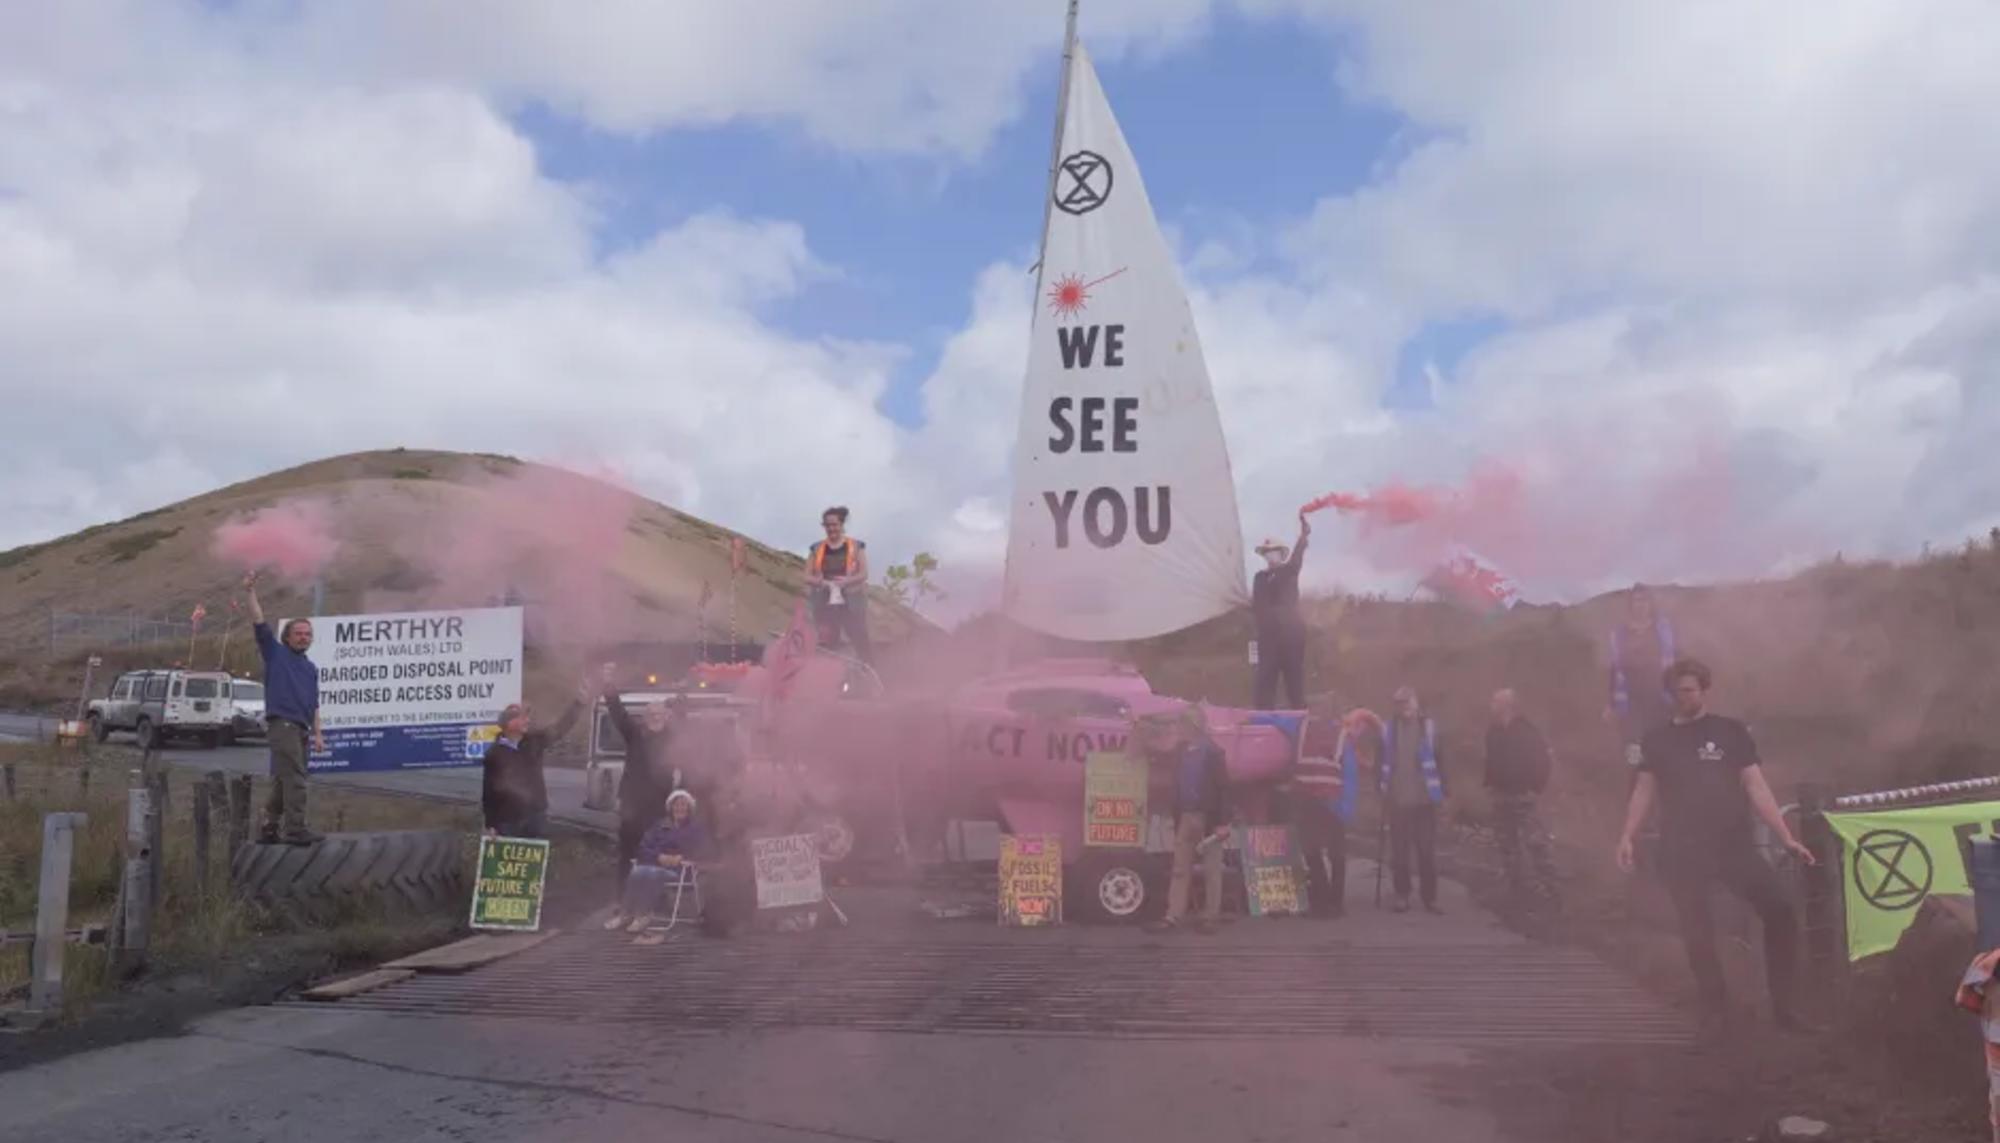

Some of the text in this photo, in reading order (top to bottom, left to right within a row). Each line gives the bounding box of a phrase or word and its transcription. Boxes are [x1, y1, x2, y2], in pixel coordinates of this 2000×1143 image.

[1057, 324, 1125, 369] WE
[1048, 397, 1140, 455] SEE
[1043, 485, 1172, 549] YOU
[335, 616, 463, 643] MERTHYR
[335, 640, 463, 661] (SOUTH WALES) LTD
[320, 658, 514, 683] BARGOED DISPOSAL POINT
[319, 681, 495, 705] THORISED ACCESS ONLY
[958, 723, 1128, 763] ACT NOW
[1088, 824, 1137, 841] FUTURE
[487, 843, 544, 863] A CLEAN
[497, 860, 528, 877] SAFE
[480, 878, 523, 895] FUTURE
